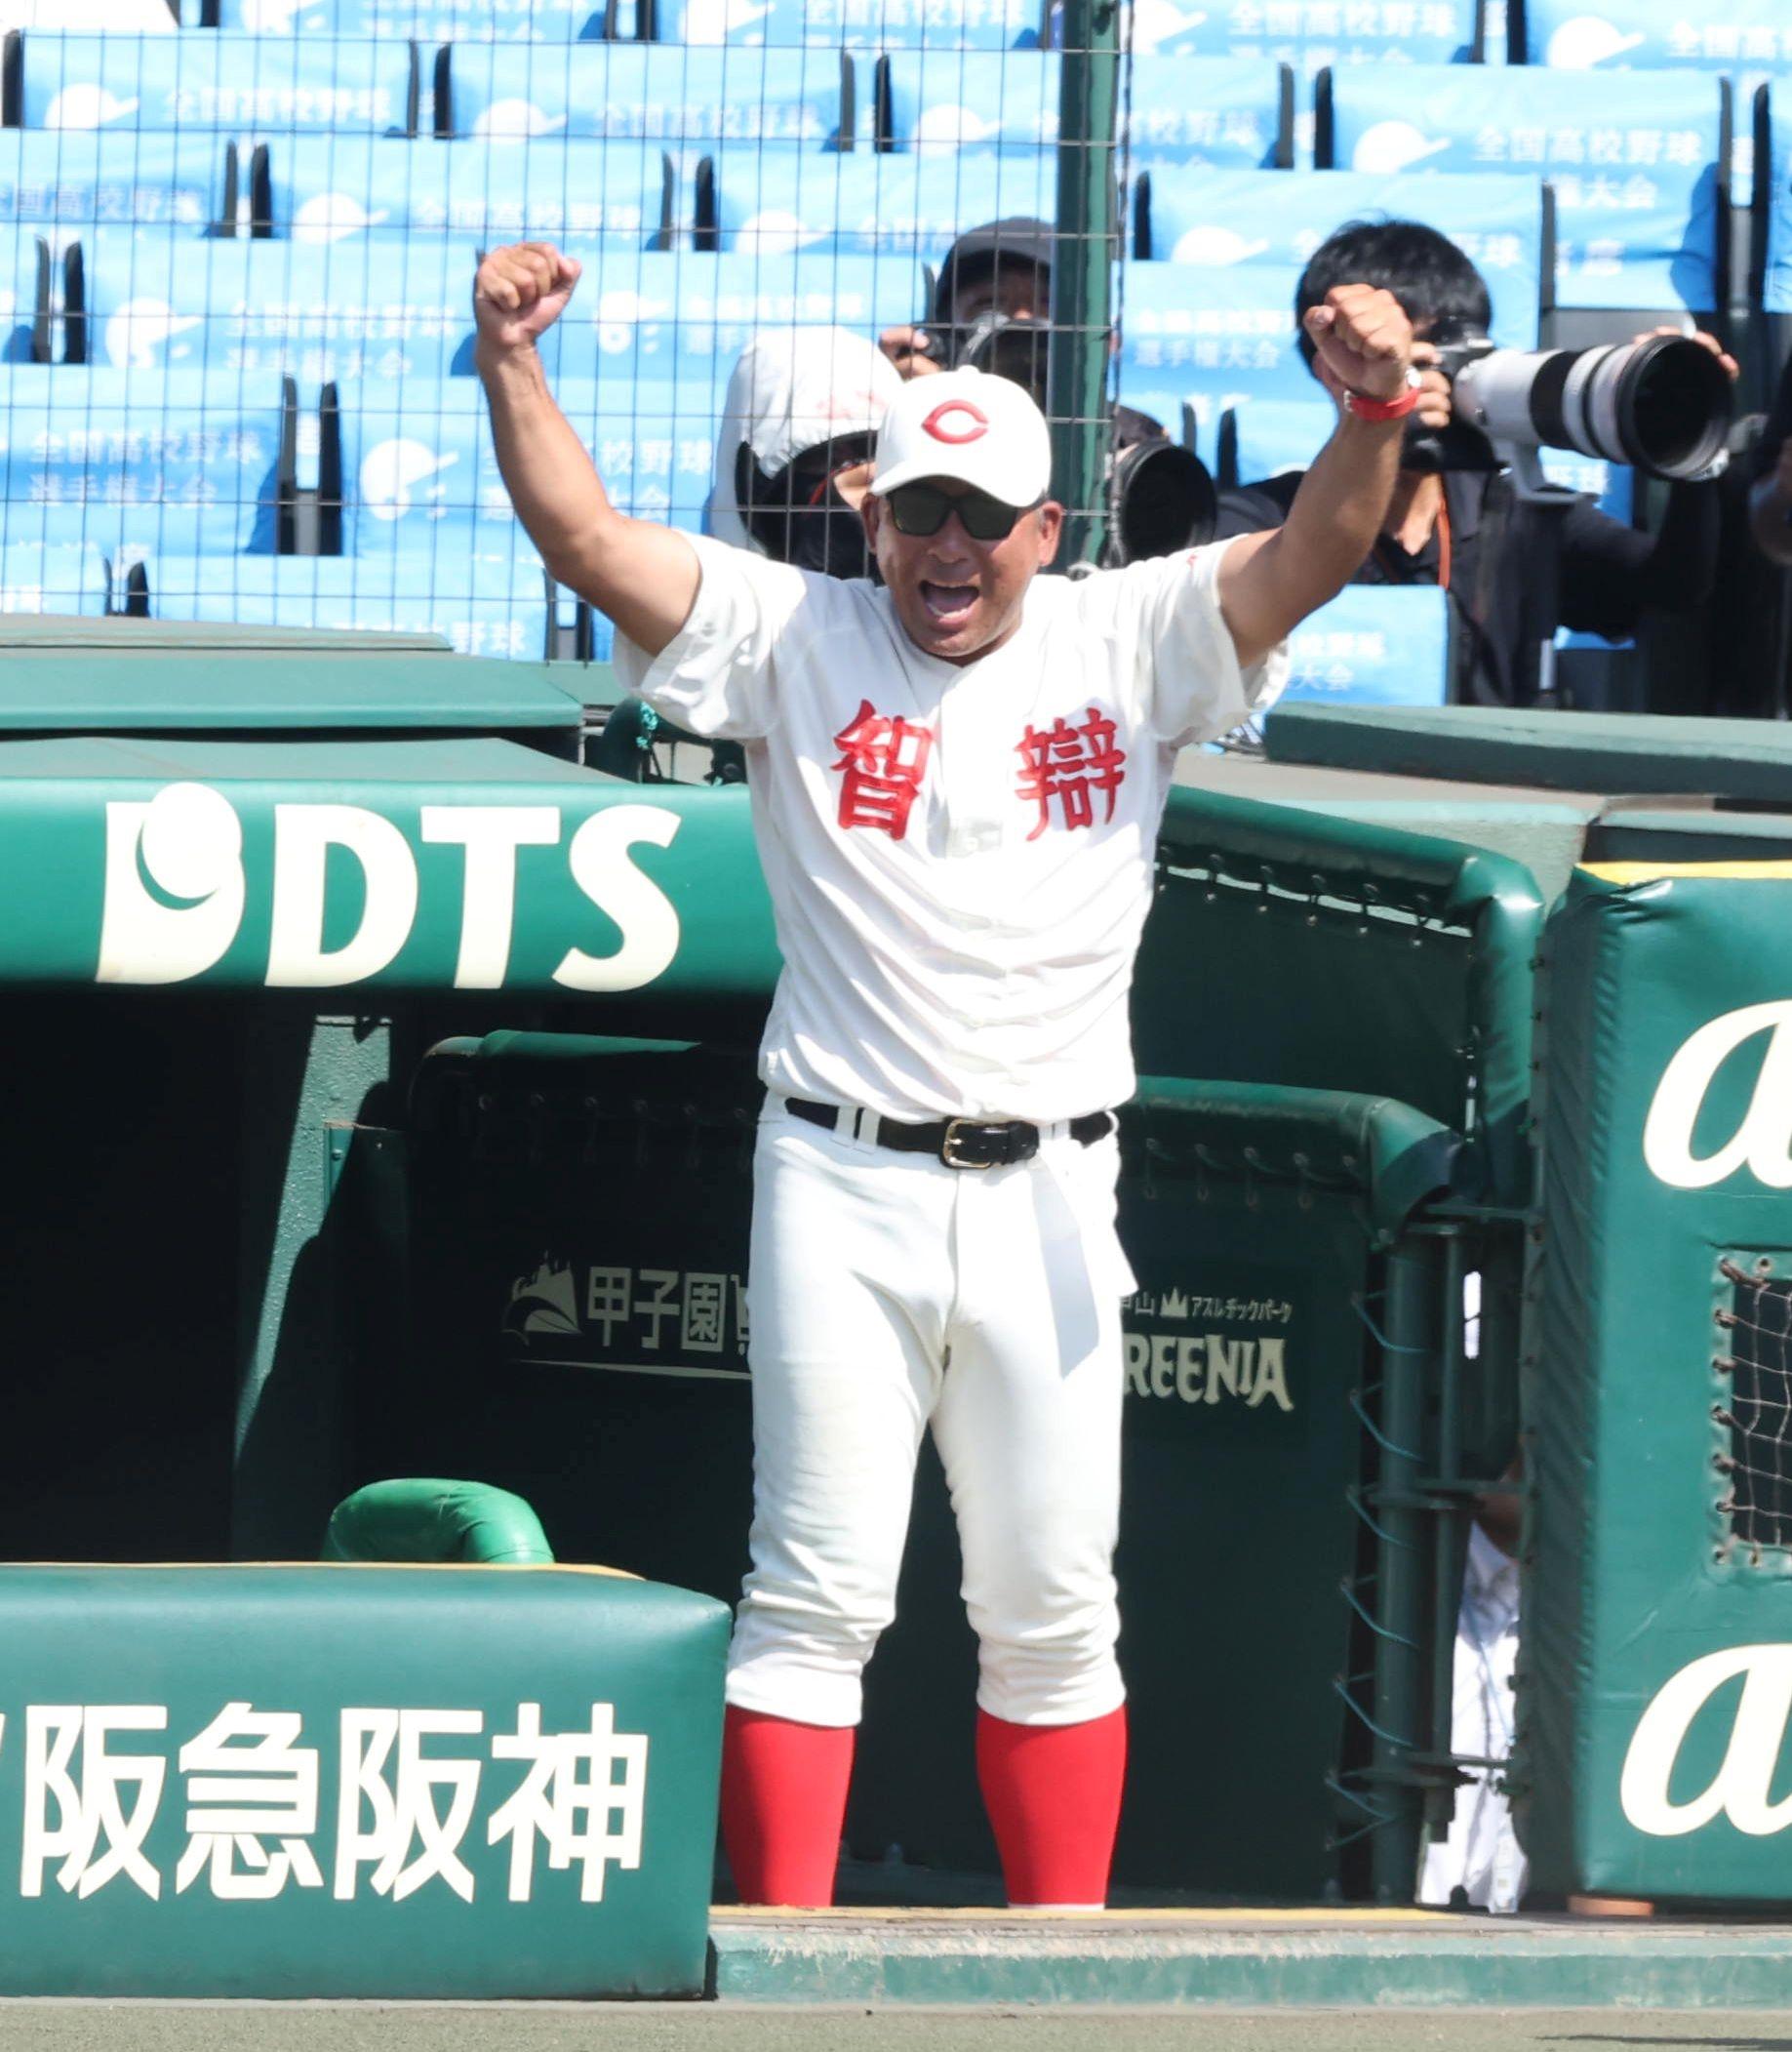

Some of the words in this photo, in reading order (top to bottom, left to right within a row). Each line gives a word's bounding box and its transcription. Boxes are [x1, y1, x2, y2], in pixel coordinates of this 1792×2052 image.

[1666, 20, 1792, 60] 全国高
[1472, 127, 1703, 165] 全国高校野球
[923, 399, 989, 445] C
[263, 802, 683, 992] DTS
[1190, 1295, 1294, 1324] アスレチックパーク
[20, 1702, 649, 1904] 阪急阪神
